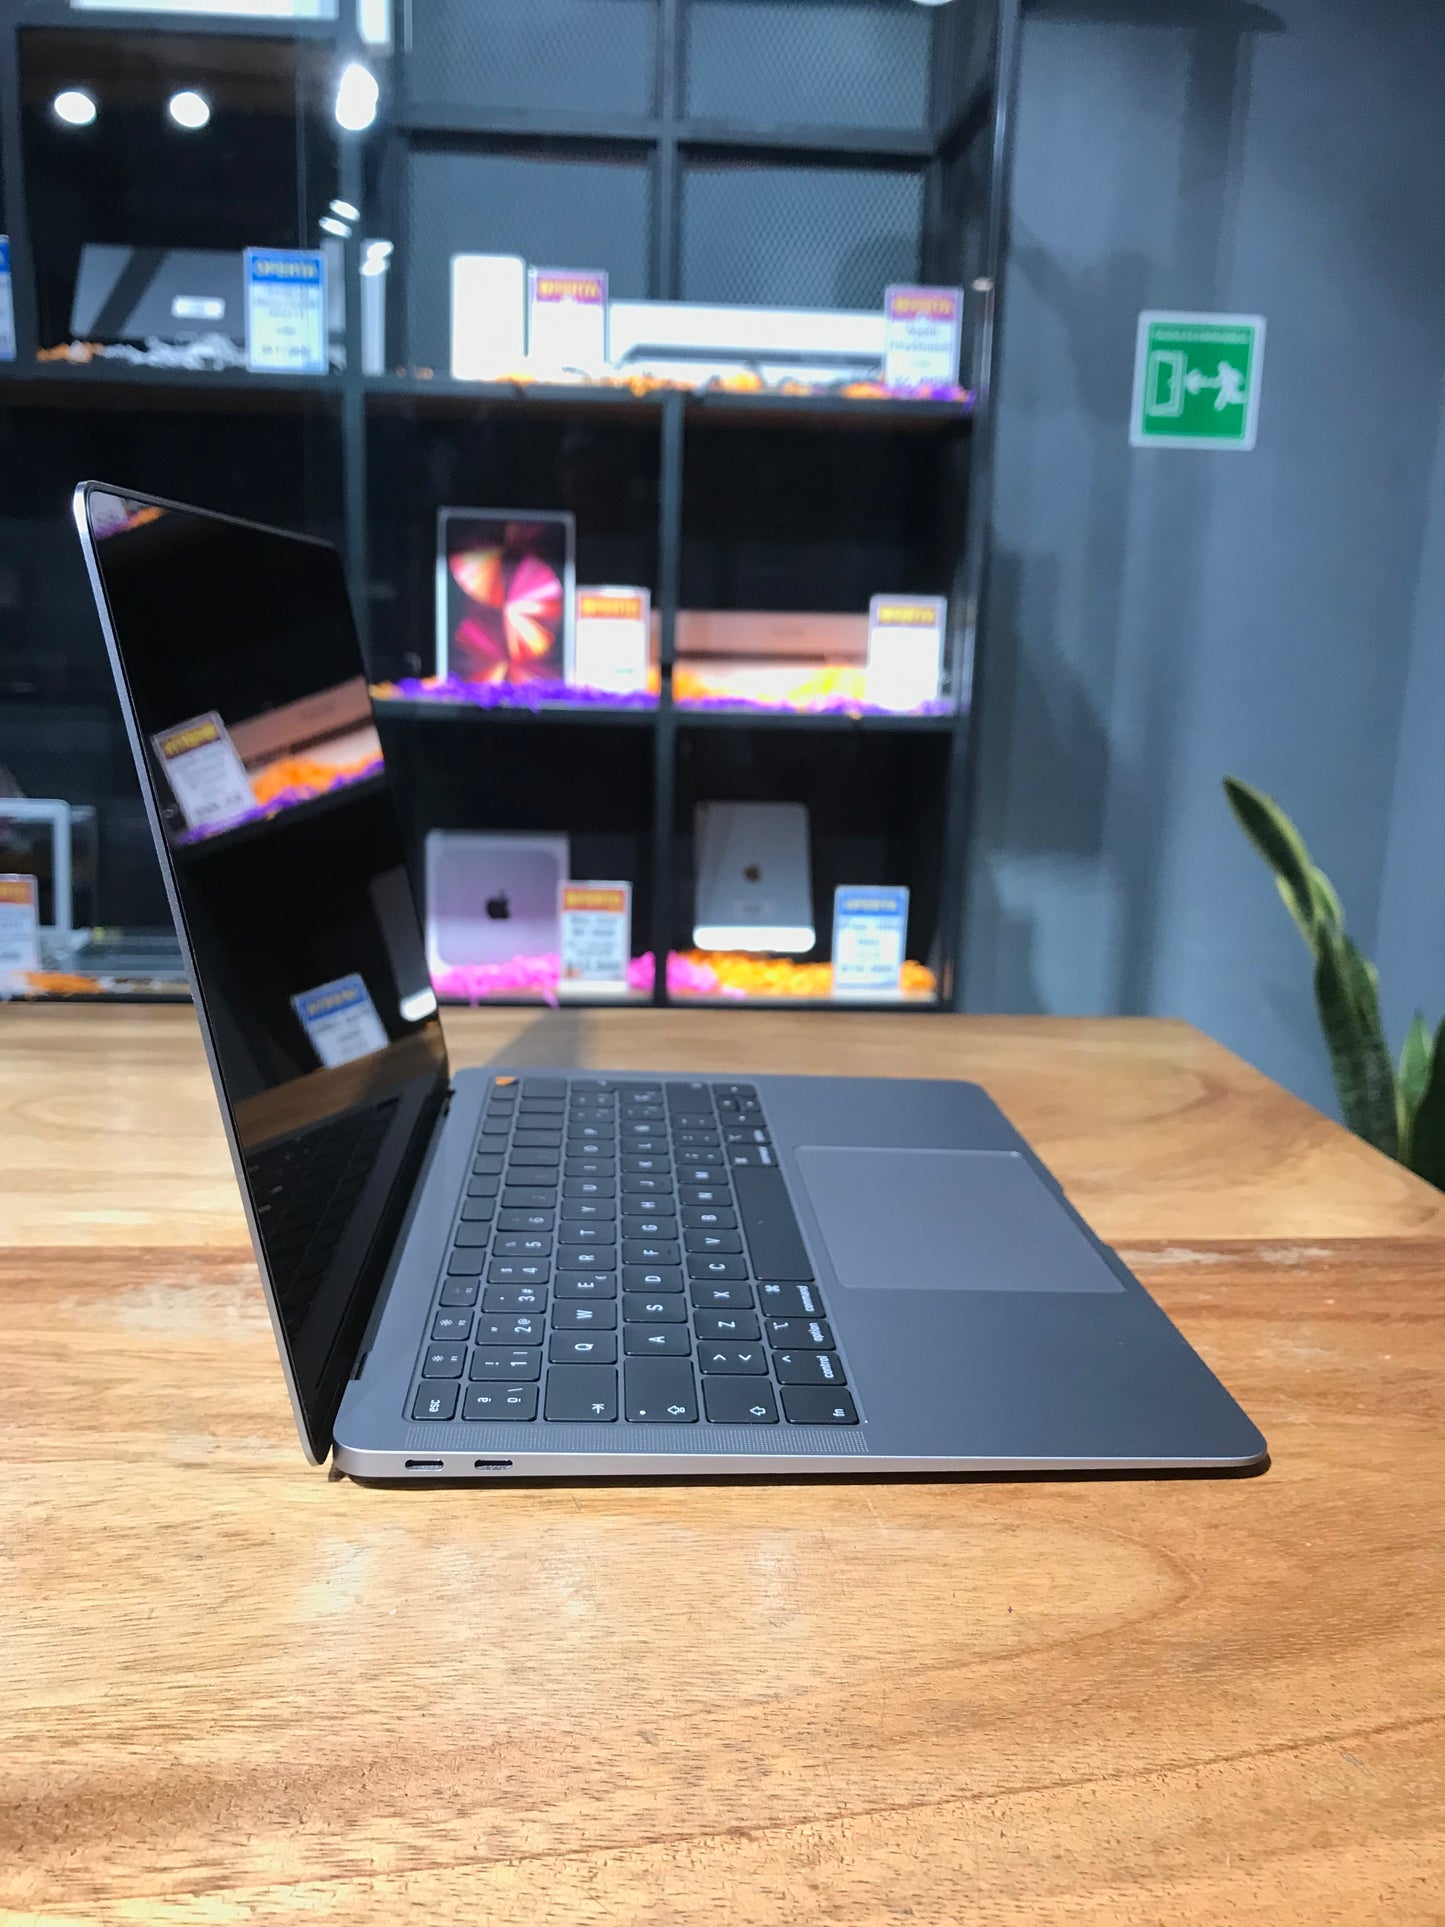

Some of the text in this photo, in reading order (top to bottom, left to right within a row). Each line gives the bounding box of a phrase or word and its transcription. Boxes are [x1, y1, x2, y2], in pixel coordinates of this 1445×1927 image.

[815, 1355, 834, 1379] control
[428, 1399, 441, 1413] esc
[832, 1408, 845, 1417] fn
